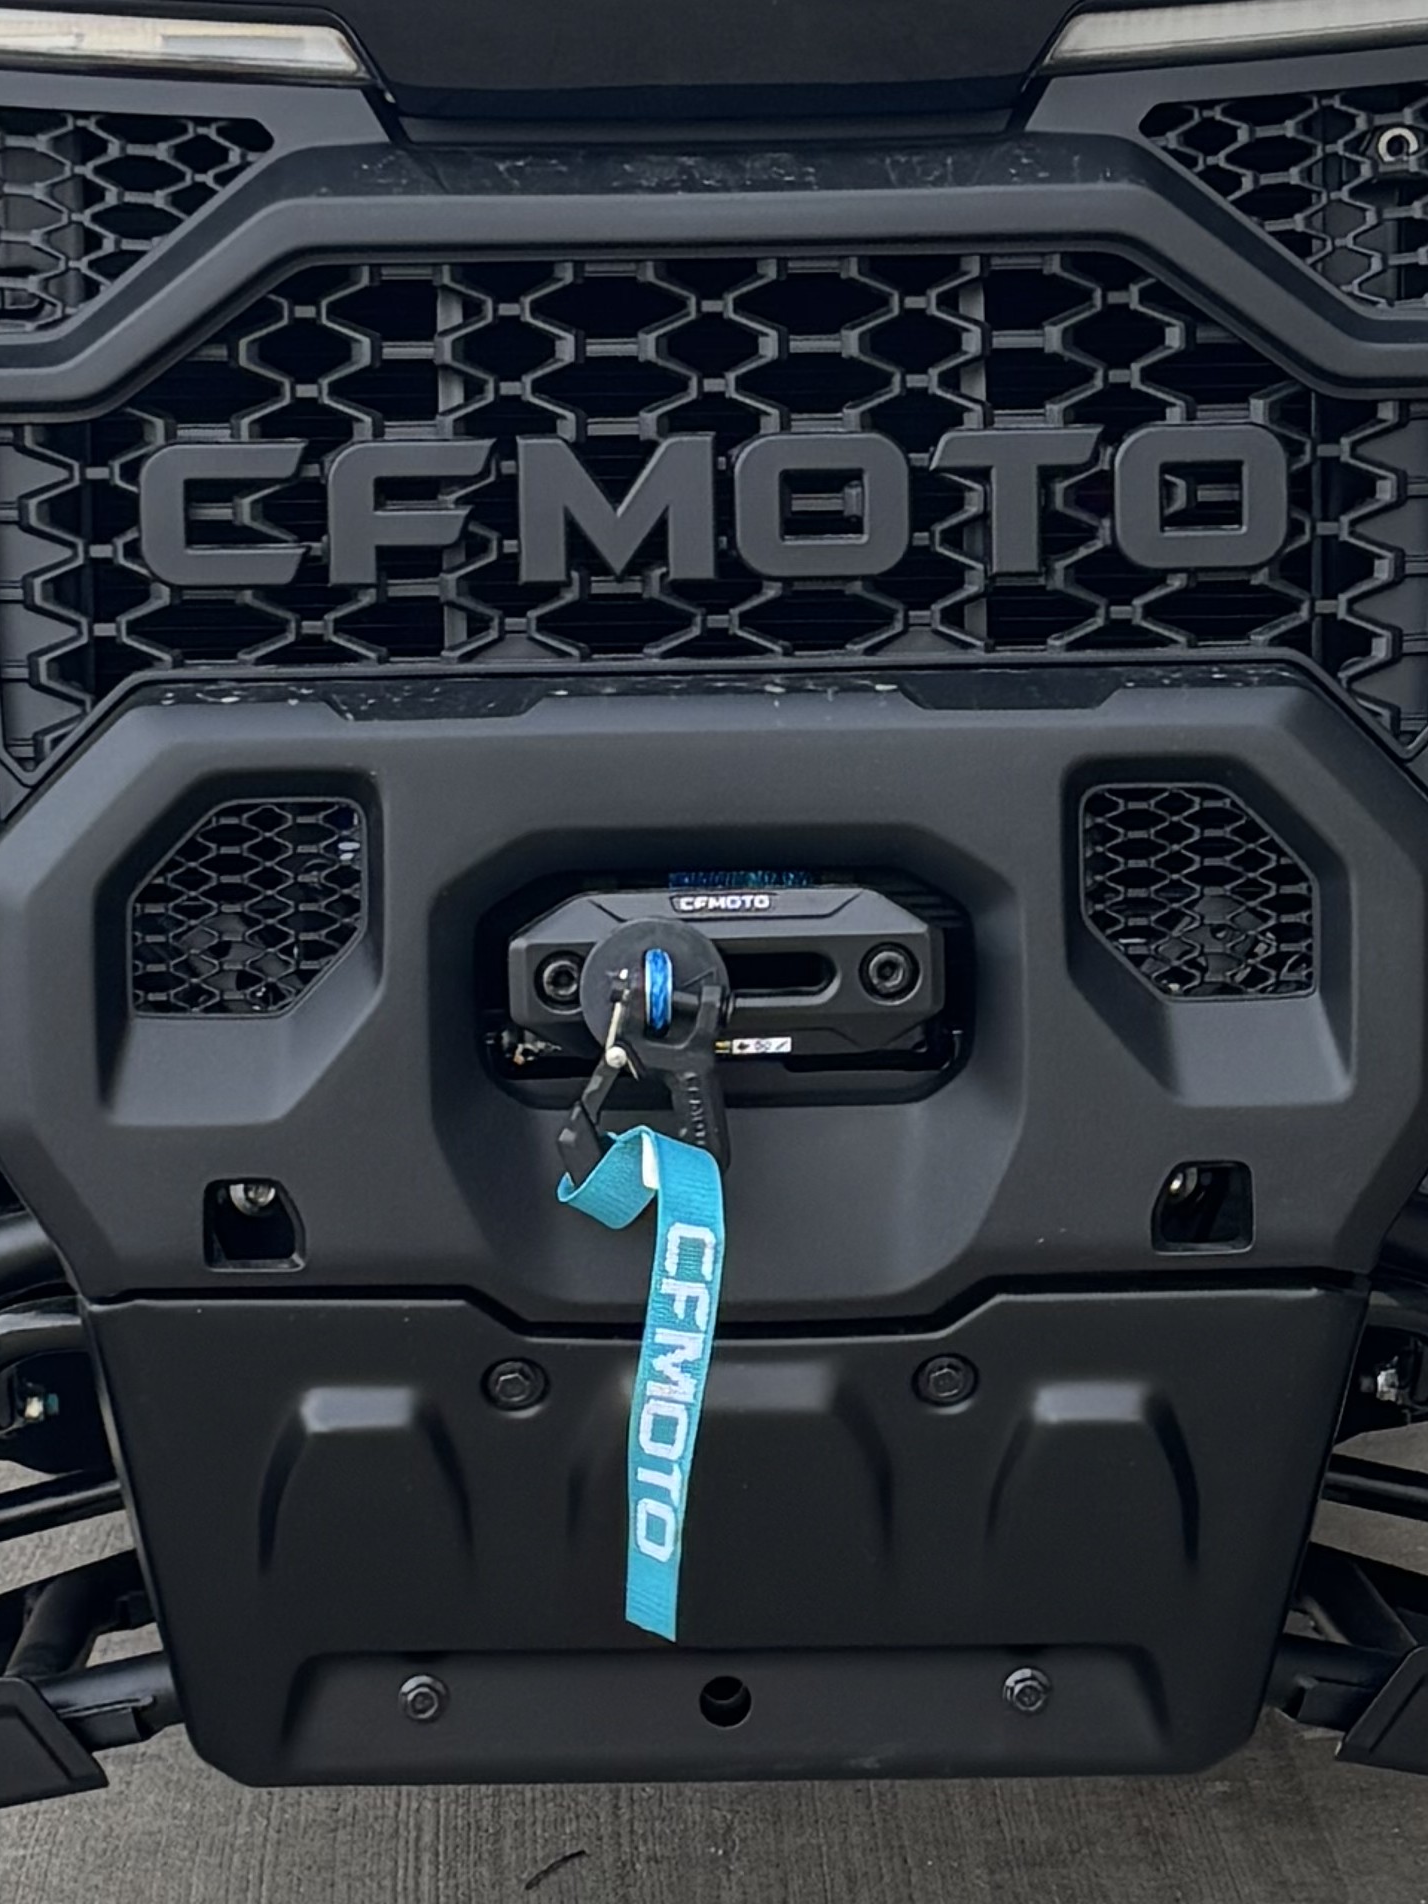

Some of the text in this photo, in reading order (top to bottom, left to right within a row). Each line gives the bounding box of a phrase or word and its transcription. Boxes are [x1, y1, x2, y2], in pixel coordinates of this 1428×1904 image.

[139, 420, 1290, 587] CFMOTO
[679, 894, 771, 911] CFMOTO
[634, 1221, 717, 1564] CFMOTO
